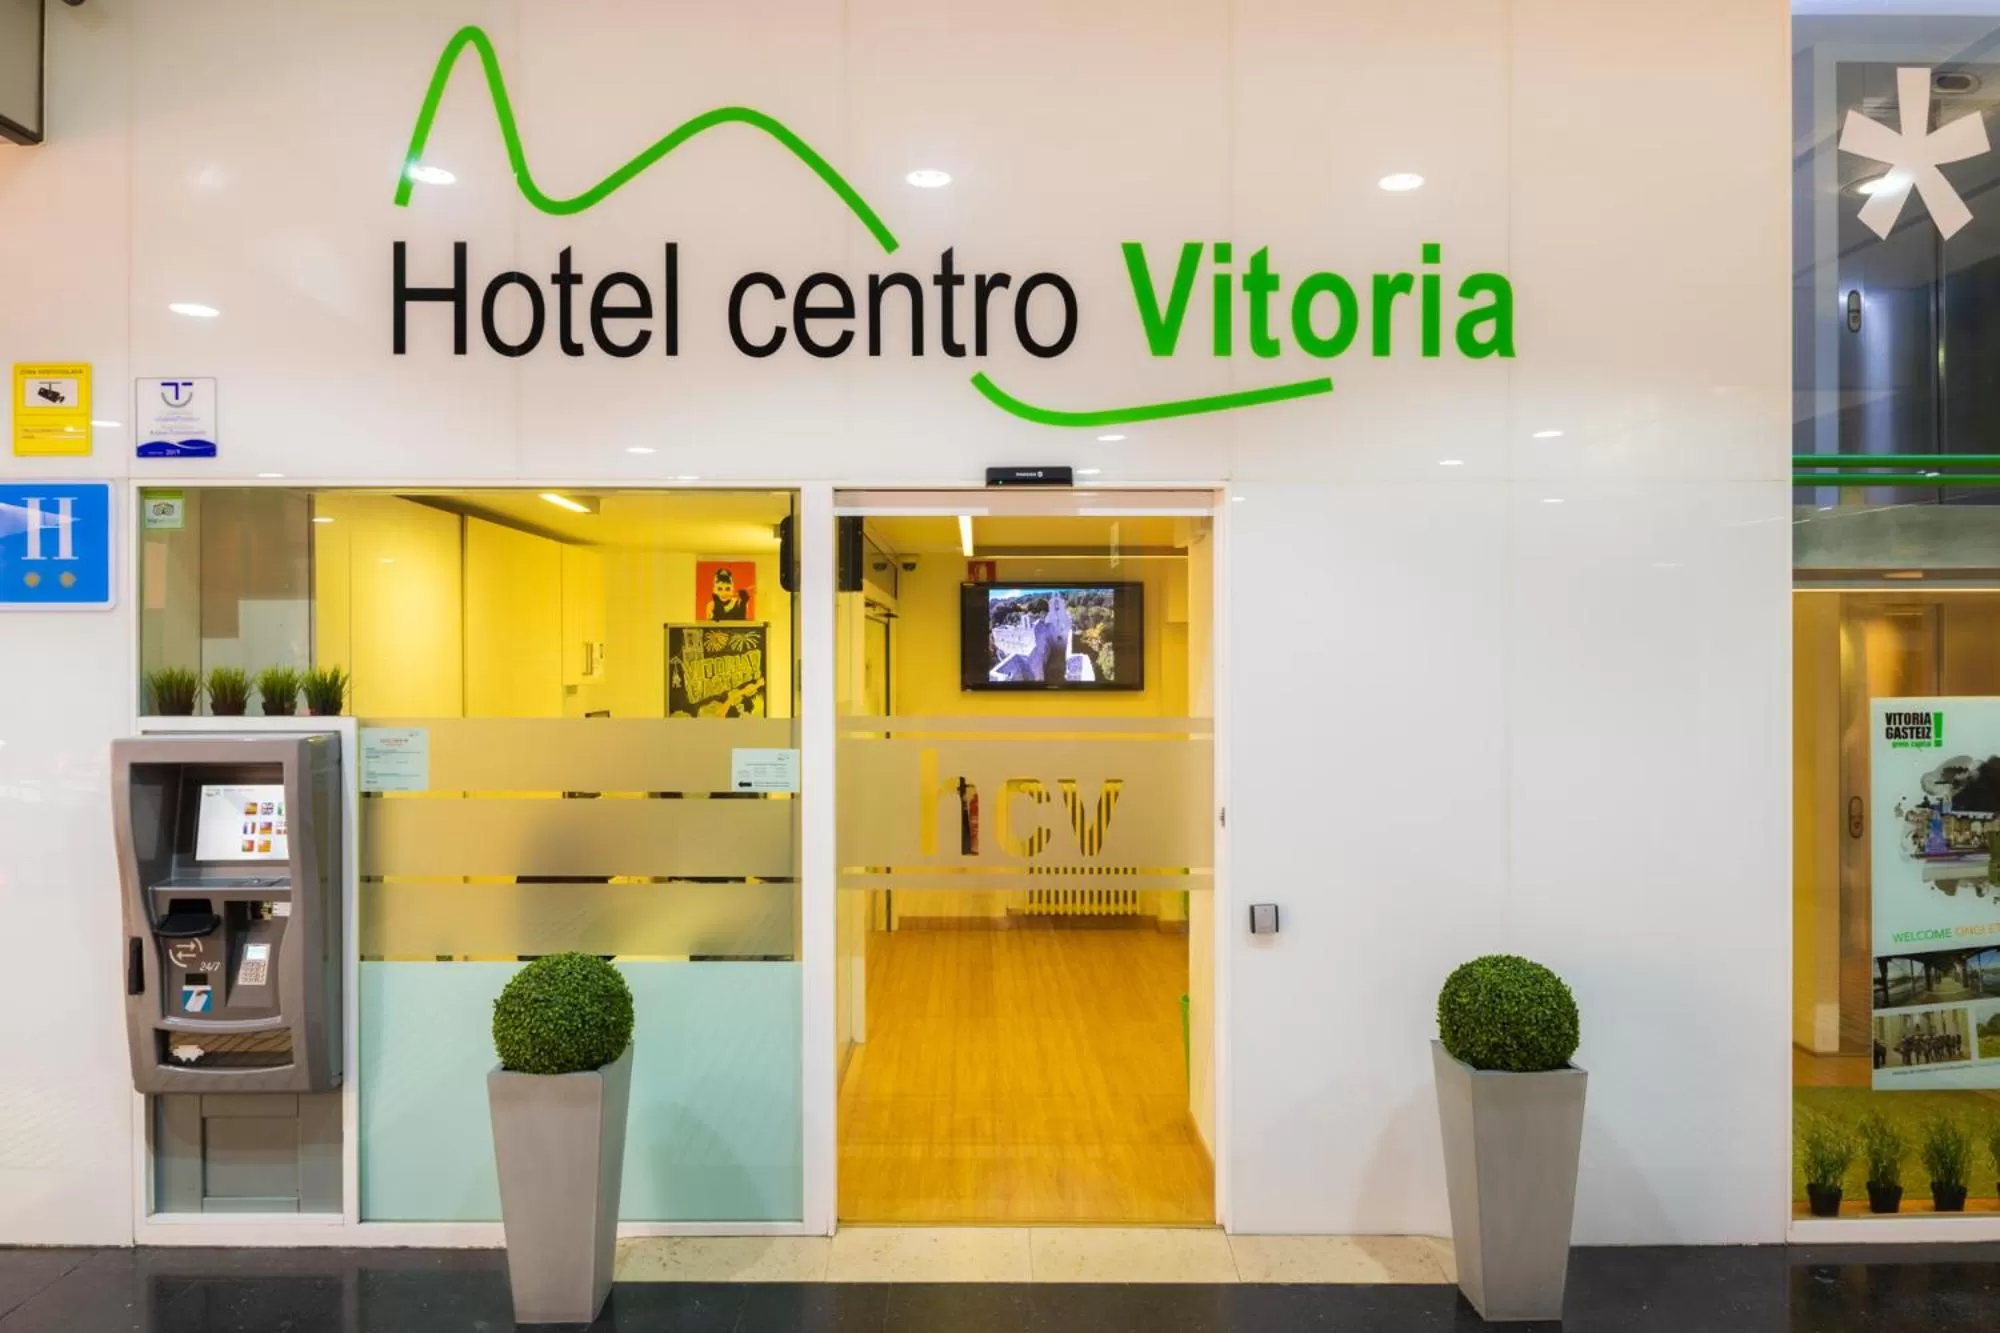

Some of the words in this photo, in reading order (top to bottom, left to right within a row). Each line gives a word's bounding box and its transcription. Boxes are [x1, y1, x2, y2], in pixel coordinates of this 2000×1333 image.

[393, 242, 678, 358] Hotel
[728, 247, 1078, 359] centro
[1121, 241, 1516, 360] Vitoria
[20, 496, 79, 561] H
[1885, 712, 1932, 726] VITORIA
[1885, 726, 1932, 740] GASTEIZ
[919, 747, 1125, 857] hcv
[1892, 927, 1953, 943] WELCOME
[199, 960, 221, 972] 24/7
